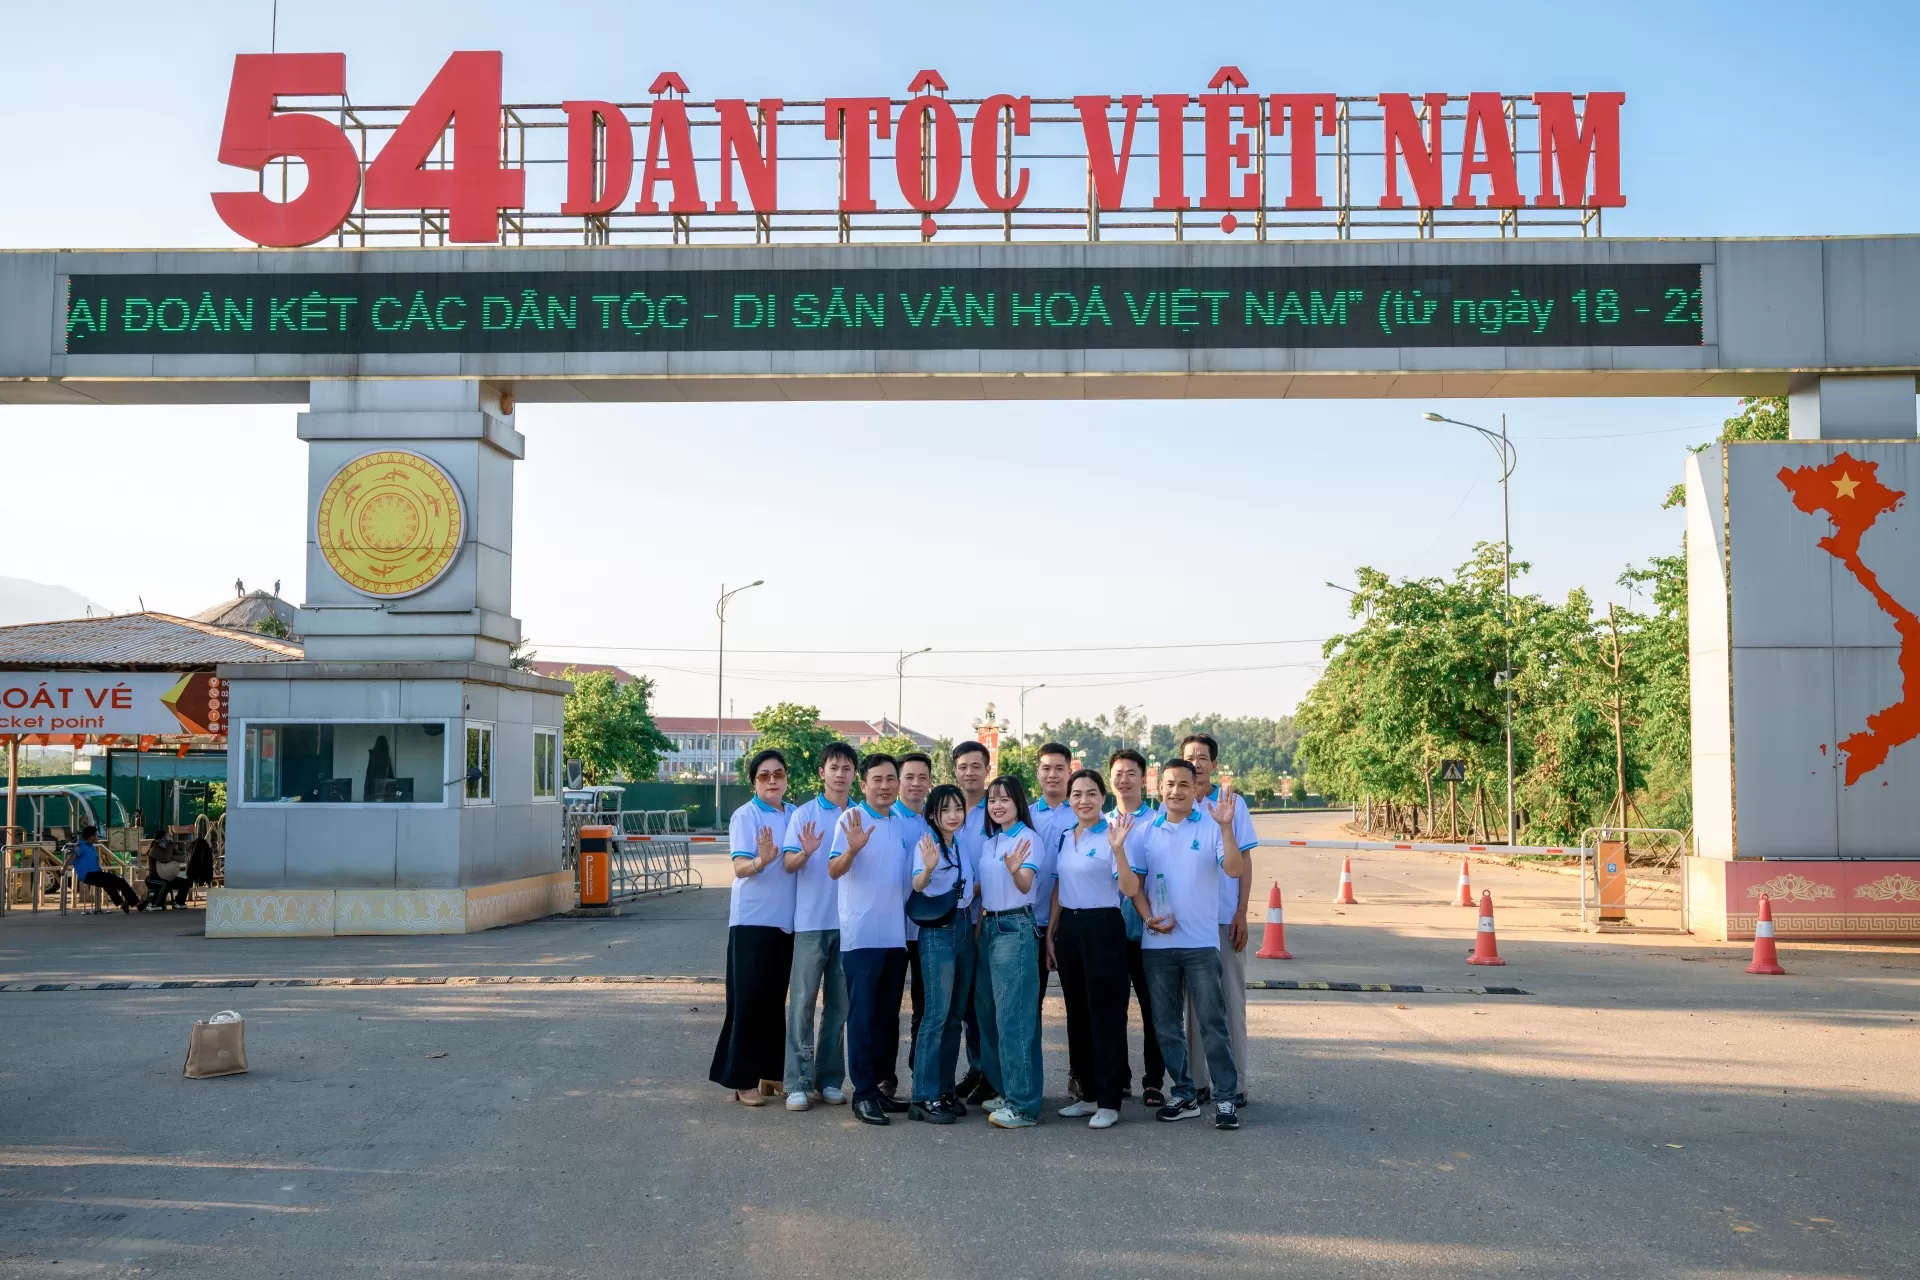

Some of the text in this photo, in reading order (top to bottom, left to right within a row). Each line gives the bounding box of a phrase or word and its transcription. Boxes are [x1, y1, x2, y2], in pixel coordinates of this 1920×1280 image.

[212, 51, 1626, 246] 54 DÂN TỘC VIỆT NAM
[121, 291, 253, 331] ĐOÀN
[371, 290, 466, 330] CÁC
[482, 289, 577, 330] DÂN
[591, 292, 689, 335] TỘC
[733, 294, 776, 328] DI
[791, 287, 885, 328] SẢN
[899, 286, 995, 327] VĂN
[1011, 285, 1113, 326] HOÁ
[1123, 288, 1230, 332] VIỆT
[1453, 289, 1555, 334] ngày
[1571, 289, 1620, 323] 18
[0, 681, 132, 709] OÁT VÉ
[51, 715, 104, 731] point
